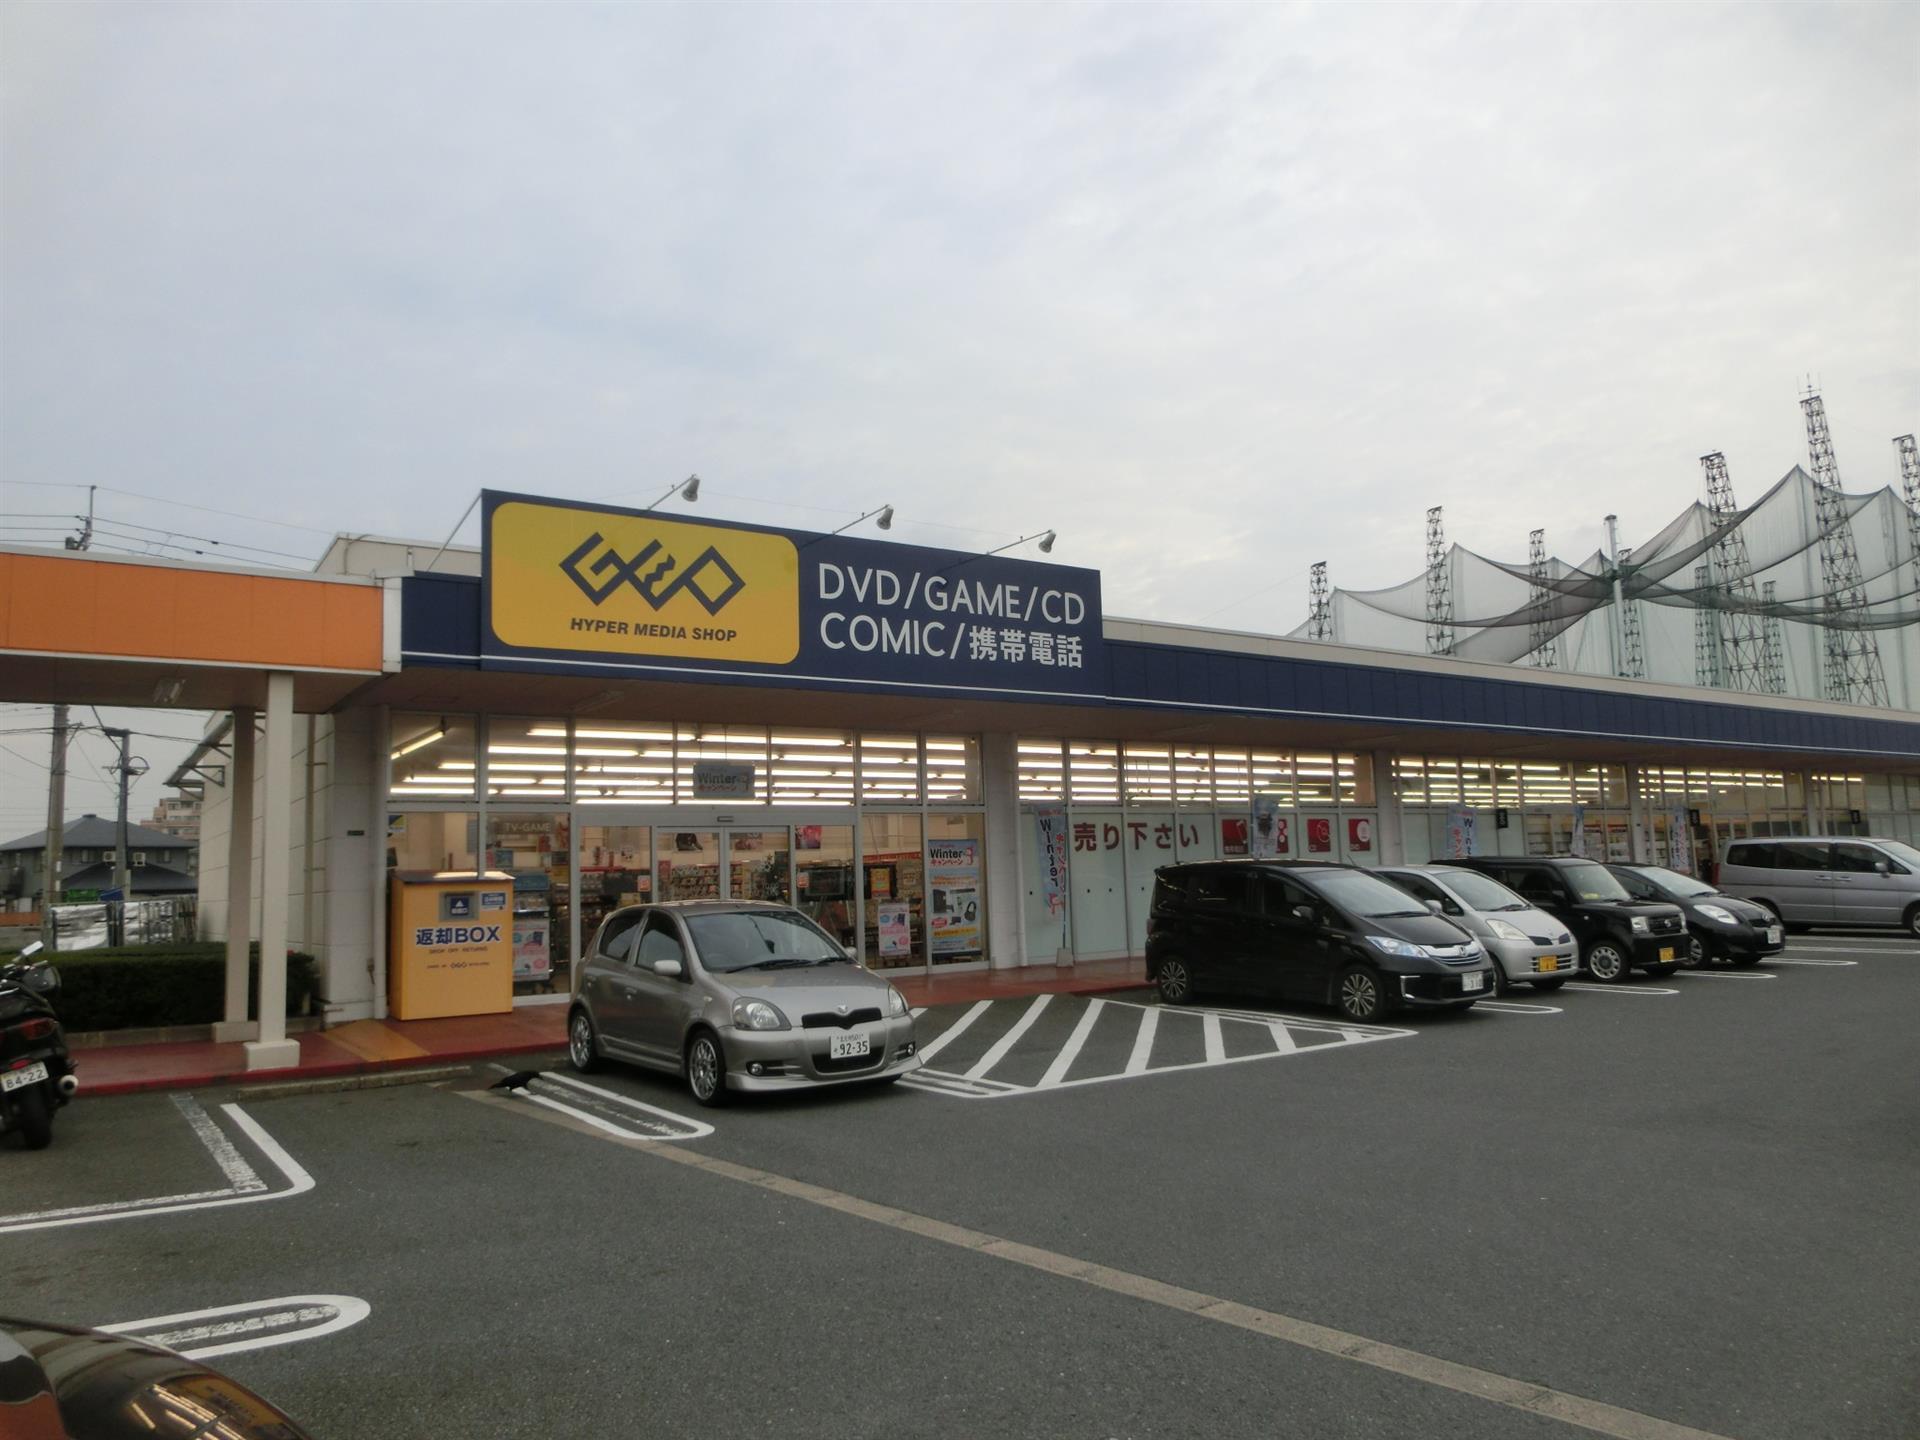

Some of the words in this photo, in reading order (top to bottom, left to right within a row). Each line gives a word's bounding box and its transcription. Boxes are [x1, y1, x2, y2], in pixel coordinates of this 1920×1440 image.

[818, 562, 1086, 626] DVD/GAME/CD
[570, 617, 629, 637] HYPER
[633, 623, 688, 641] MEDIA
[691, 626, 738, 643] SHOP
[820, 612, 1084, 669] COMIC/携帯電話
[697, 772, 737, 785] Winter
[504, 822, 552, 833] TV-GAME
[1074, 821, 1199, 853] 売り下さい
[929, 848, 964, 859] Winter
[1039, 818, 1059, 888] Winter
[416, 926, 501, 946] 返却BOX
[840, 1040, 868, 1056] 92-35
[6, 1069, 45, 1089] 84-22
